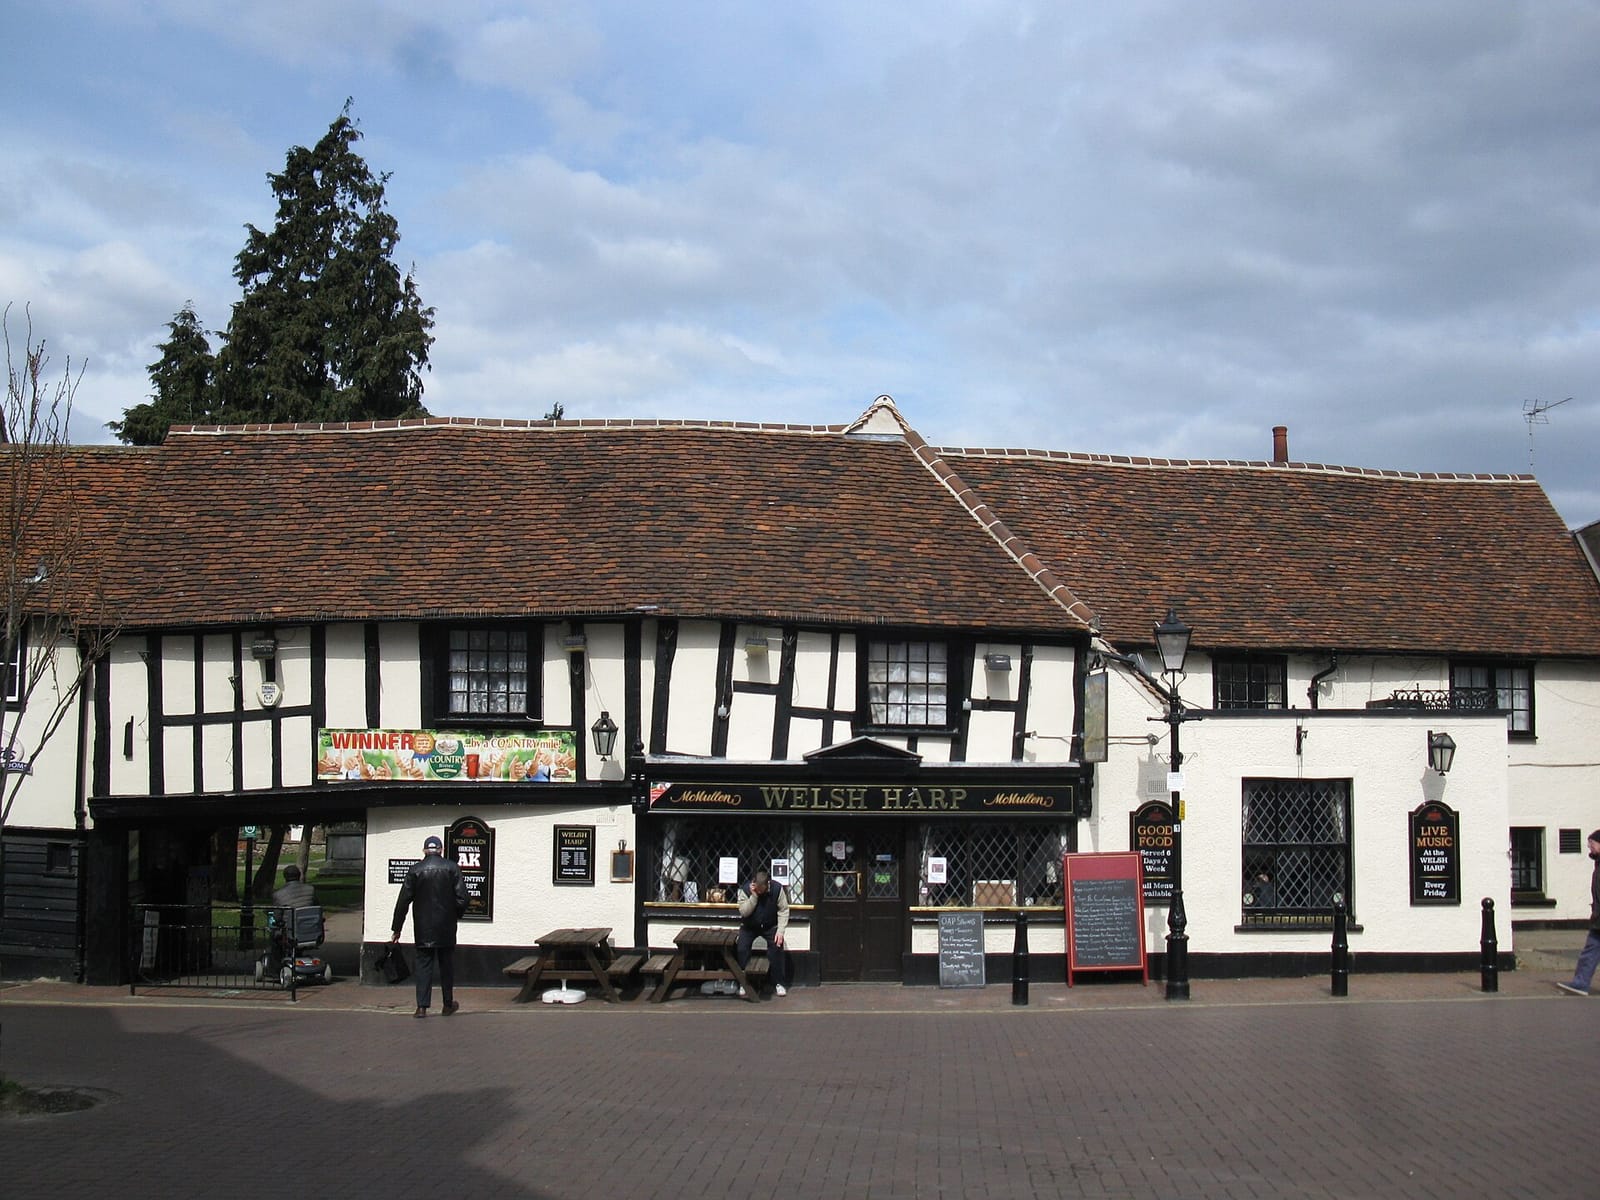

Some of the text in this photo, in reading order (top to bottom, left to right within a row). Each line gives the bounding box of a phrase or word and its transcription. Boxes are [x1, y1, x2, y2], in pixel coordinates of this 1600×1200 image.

[332, 732, 415, 750] WINNER
[491, 738, 538, 749] COUNTRY
[430, 755, 464, 764] COUNTRY
[670, 790, 741, 806] McMullen
[760, 786, 968, 810] WELSH HARP
[984, 792, 1054, 807] McMullen
[1137, 825, 1173, 836] GOOD
[1421, 826, 1448, 836] LIVE
[1138, 836, 1173, 847] FOOD
[1417, 837, 1453, 847] MUSIC
[1140, 849, 1165, 857] Served
[457, 853, 481, 867] AK
[1143, 857, 1161, 865] Days
